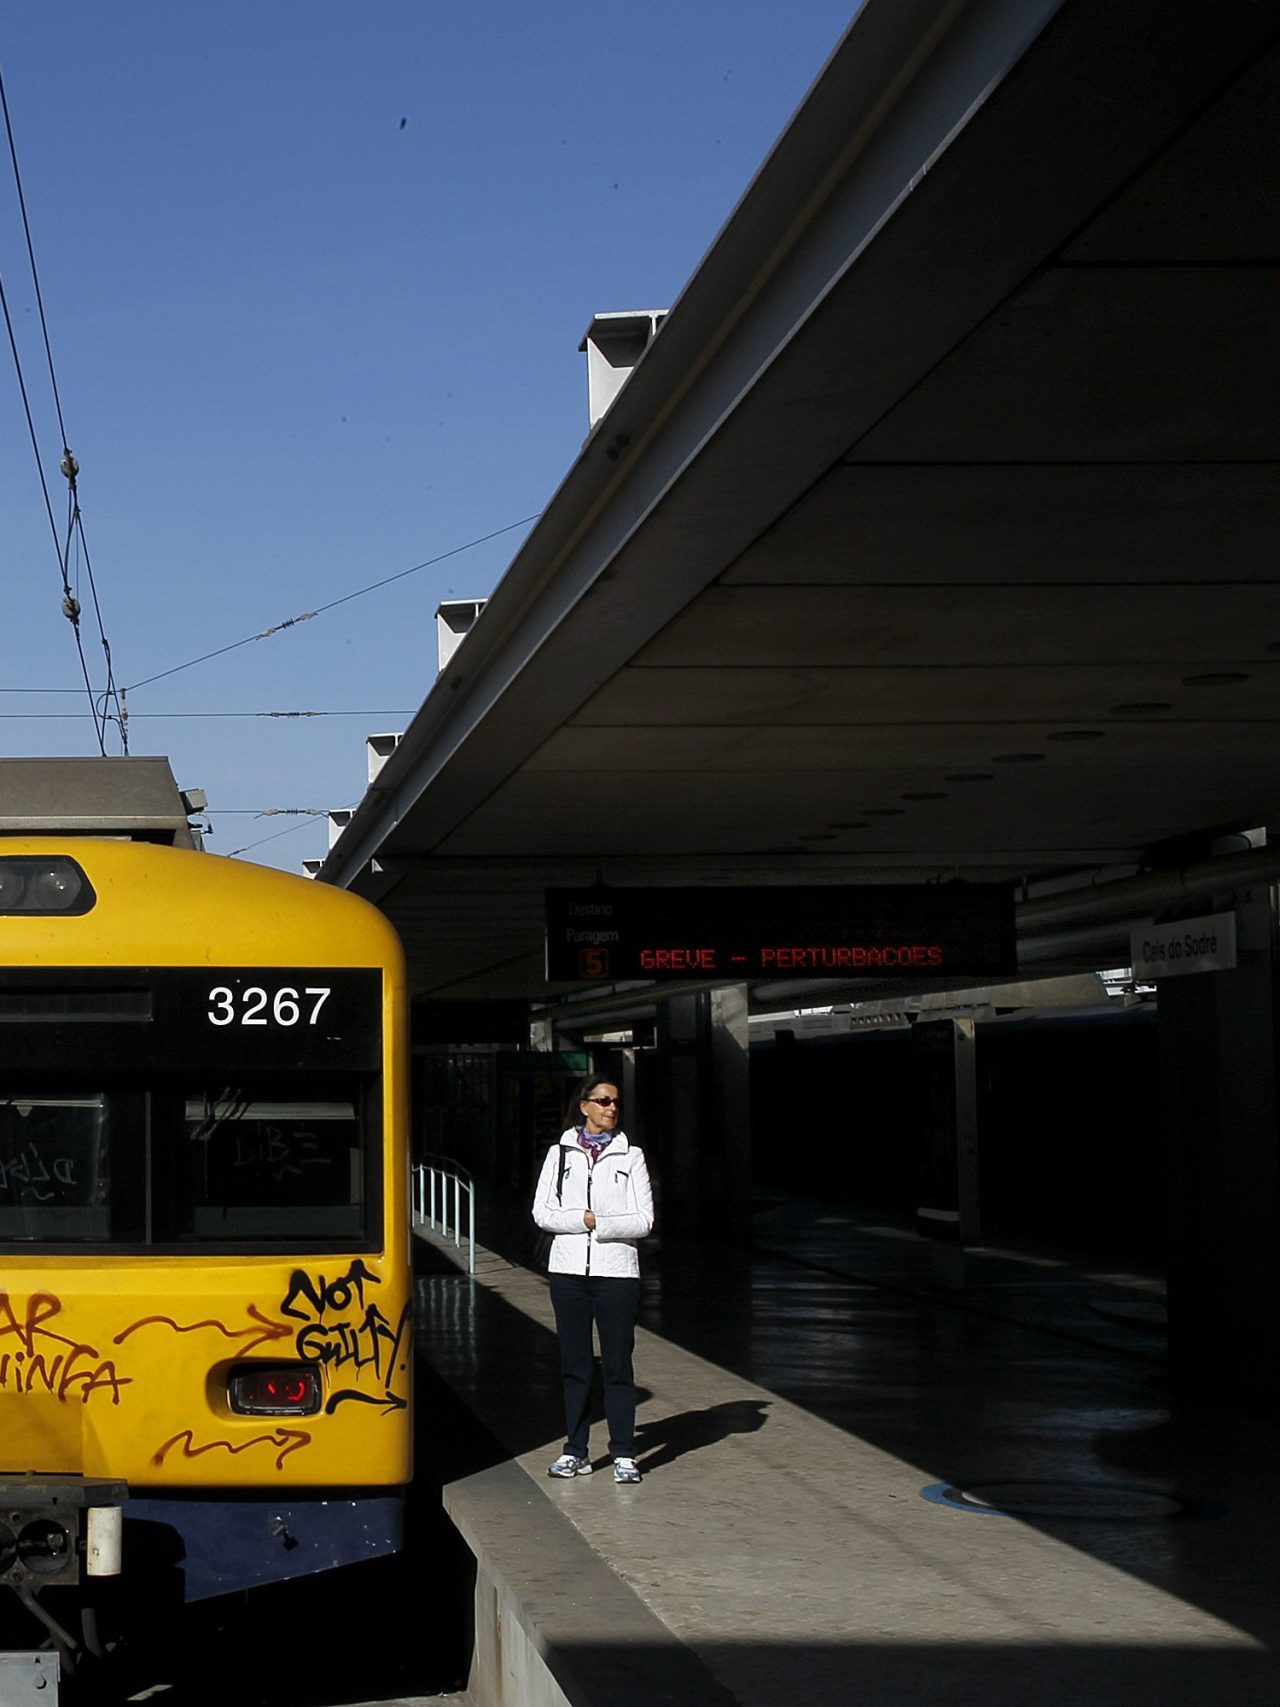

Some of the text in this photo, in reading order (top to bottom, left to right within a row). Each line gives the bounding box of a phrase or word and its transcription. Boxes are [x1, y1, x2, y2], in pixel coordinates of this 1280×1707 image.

[565, 928, 620, 945] Paragem
[1142, 928, 1217, 962] Cais do Sodré
[584, 951, 604, 977] 5
[640, 949, 718, 970] GREVE
[760, 946, 944, 969] PERTURBACOES
[207, 987, 331, 1026] 3267
[281, 1259, 381, 1321] NOT
